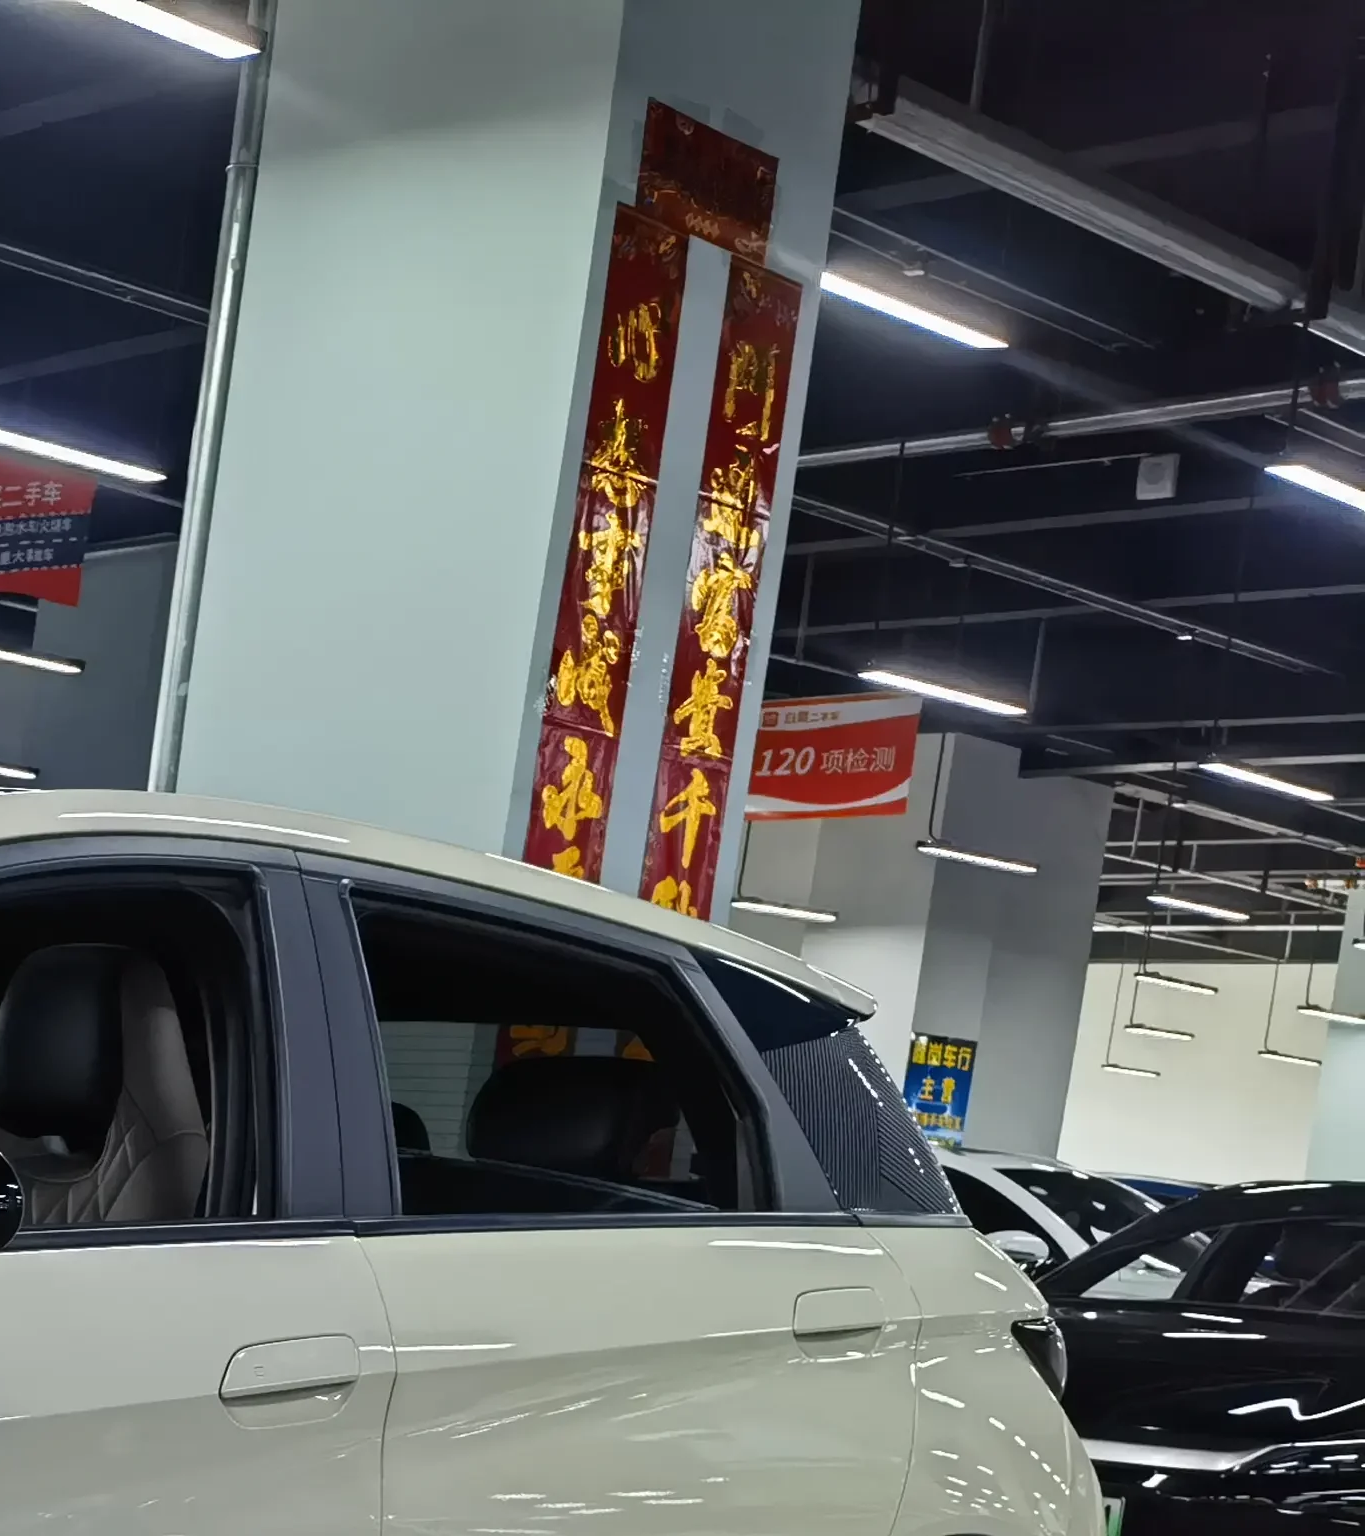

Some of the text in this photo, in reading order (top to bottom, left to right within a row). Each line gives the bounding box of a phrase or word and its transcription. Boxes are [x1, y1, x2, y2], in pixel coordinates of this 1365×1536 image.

[755, 745, 897, 777] 120 项检测
